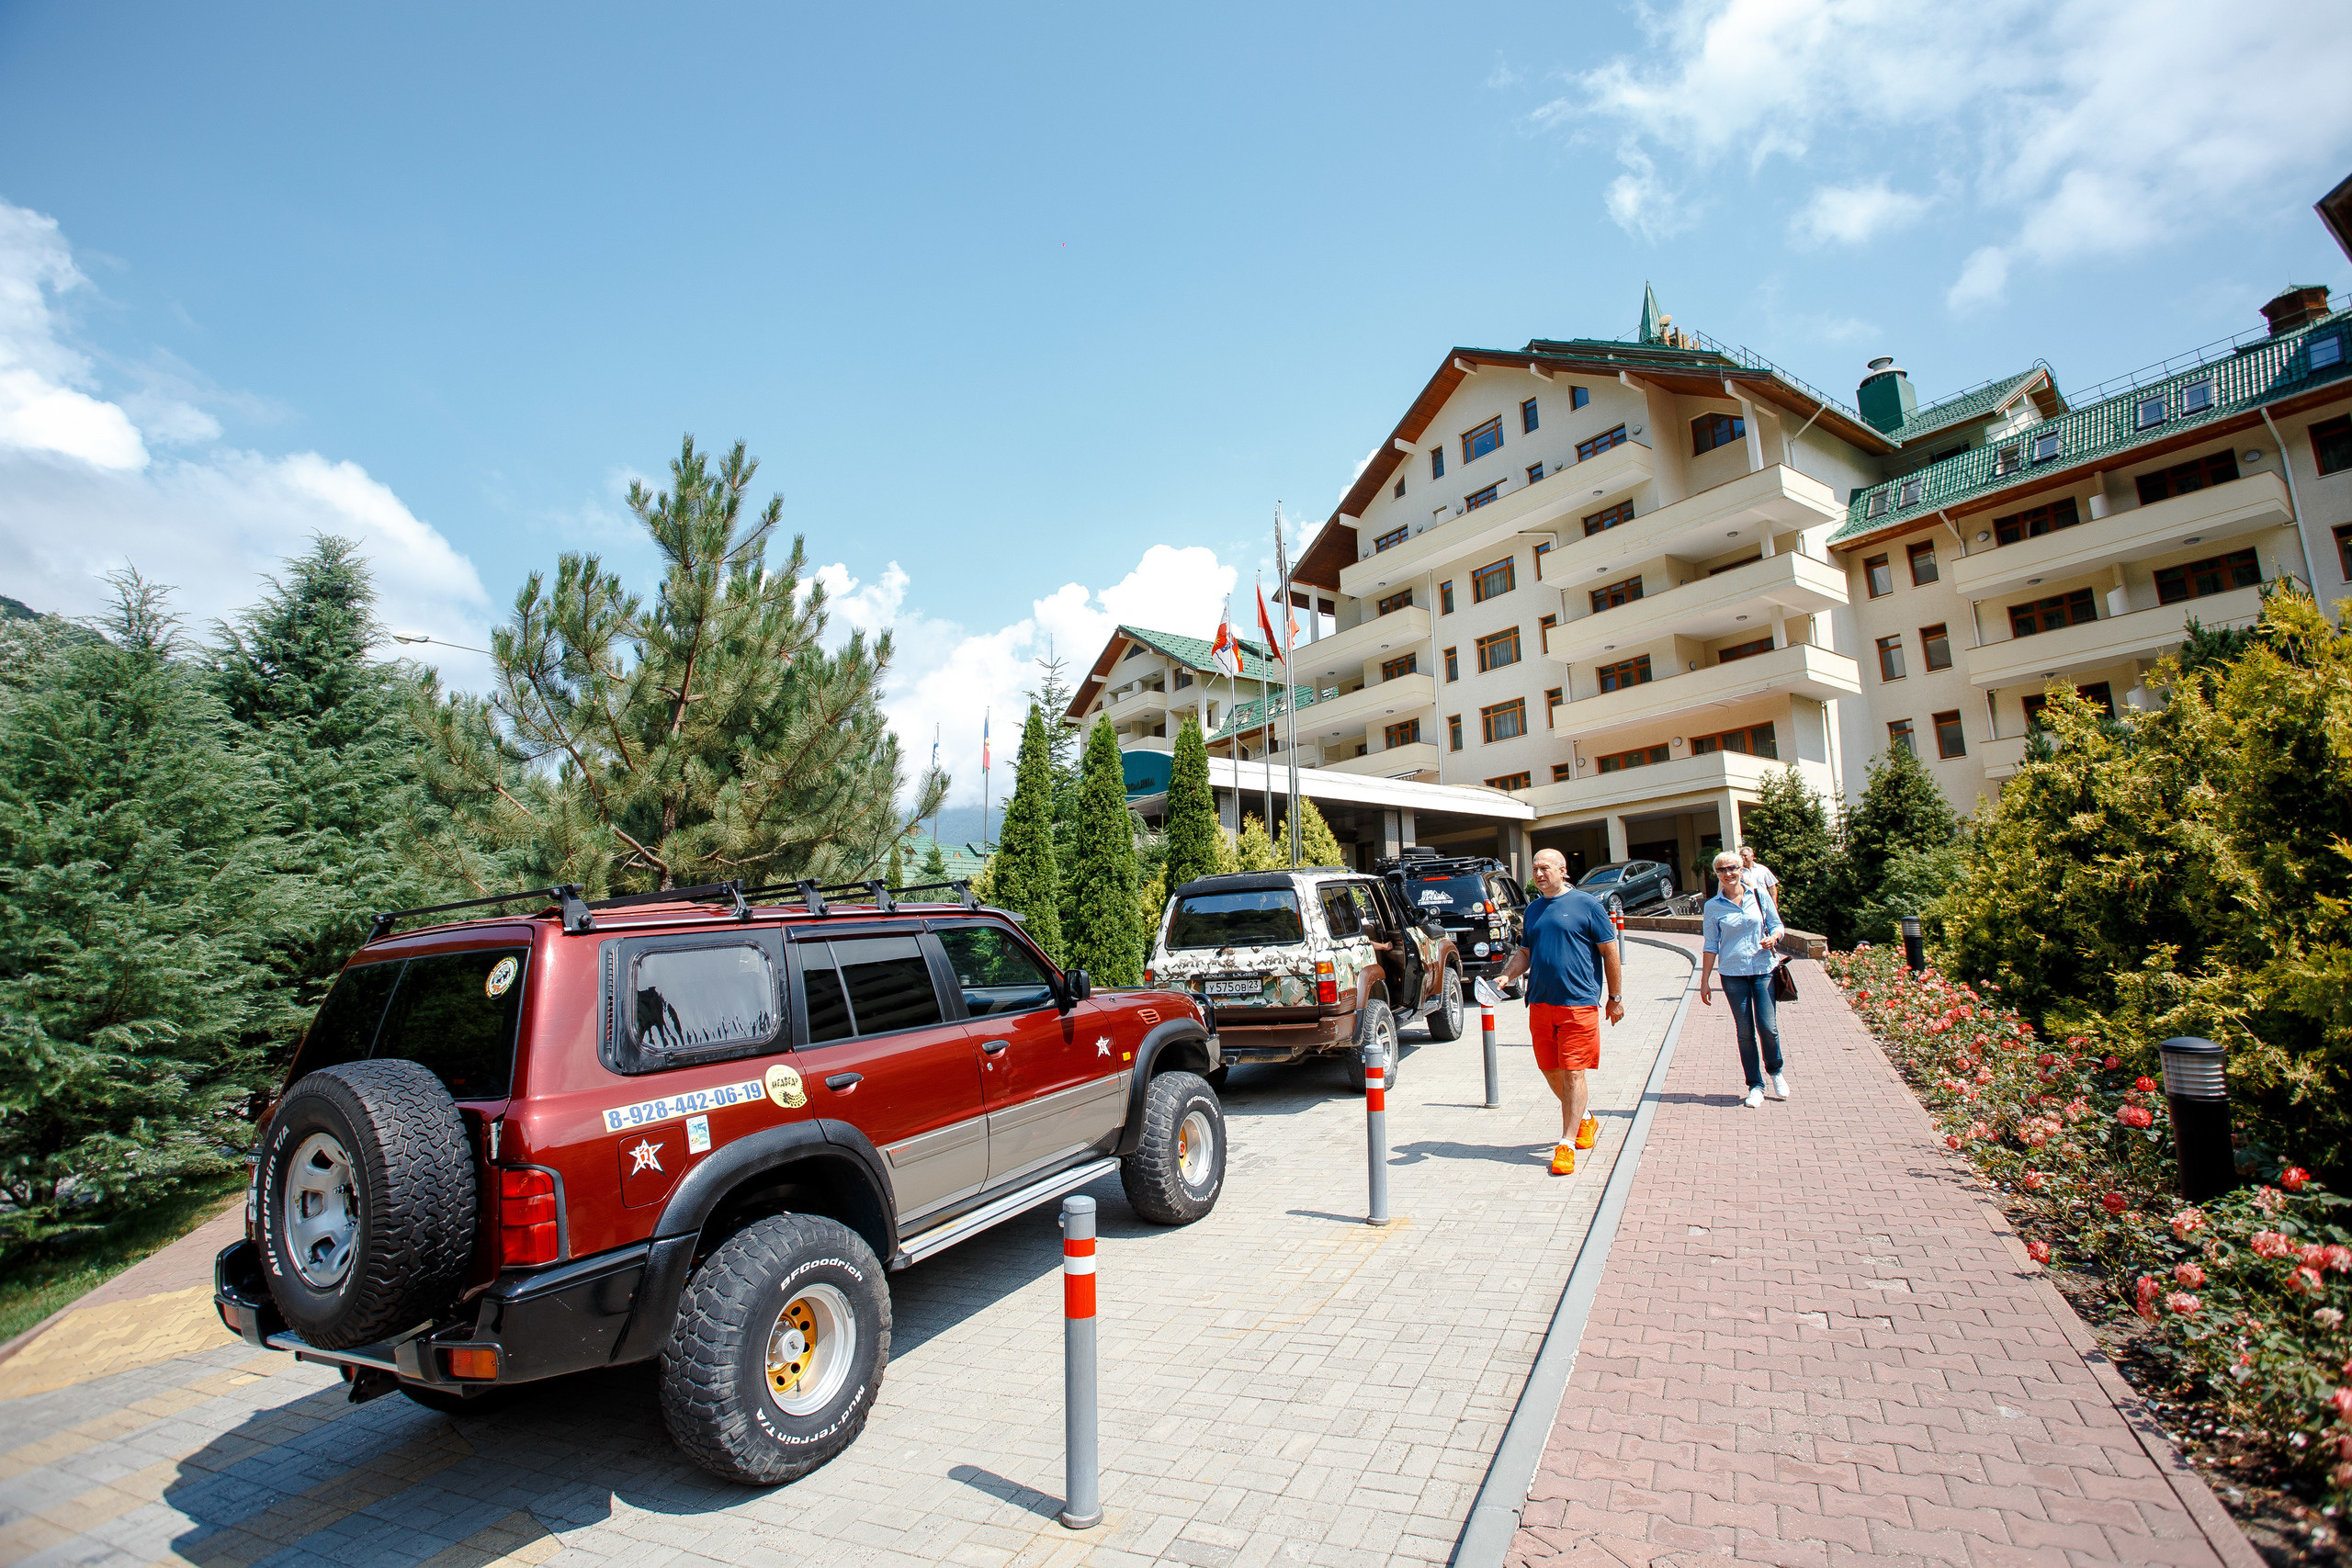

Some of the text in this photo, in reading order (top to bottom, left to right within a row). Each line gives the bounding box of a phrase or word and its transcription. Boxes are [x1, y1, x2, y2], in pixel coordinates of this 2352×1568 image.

[1249, 980, 1259, 988] 23
[608, 1082, 762, 1129] 8-928-442-06-19
[780, 1258, 864, 1292] BFGoodrich
[776, 1384, 865, 1446] Mud-Terrain
